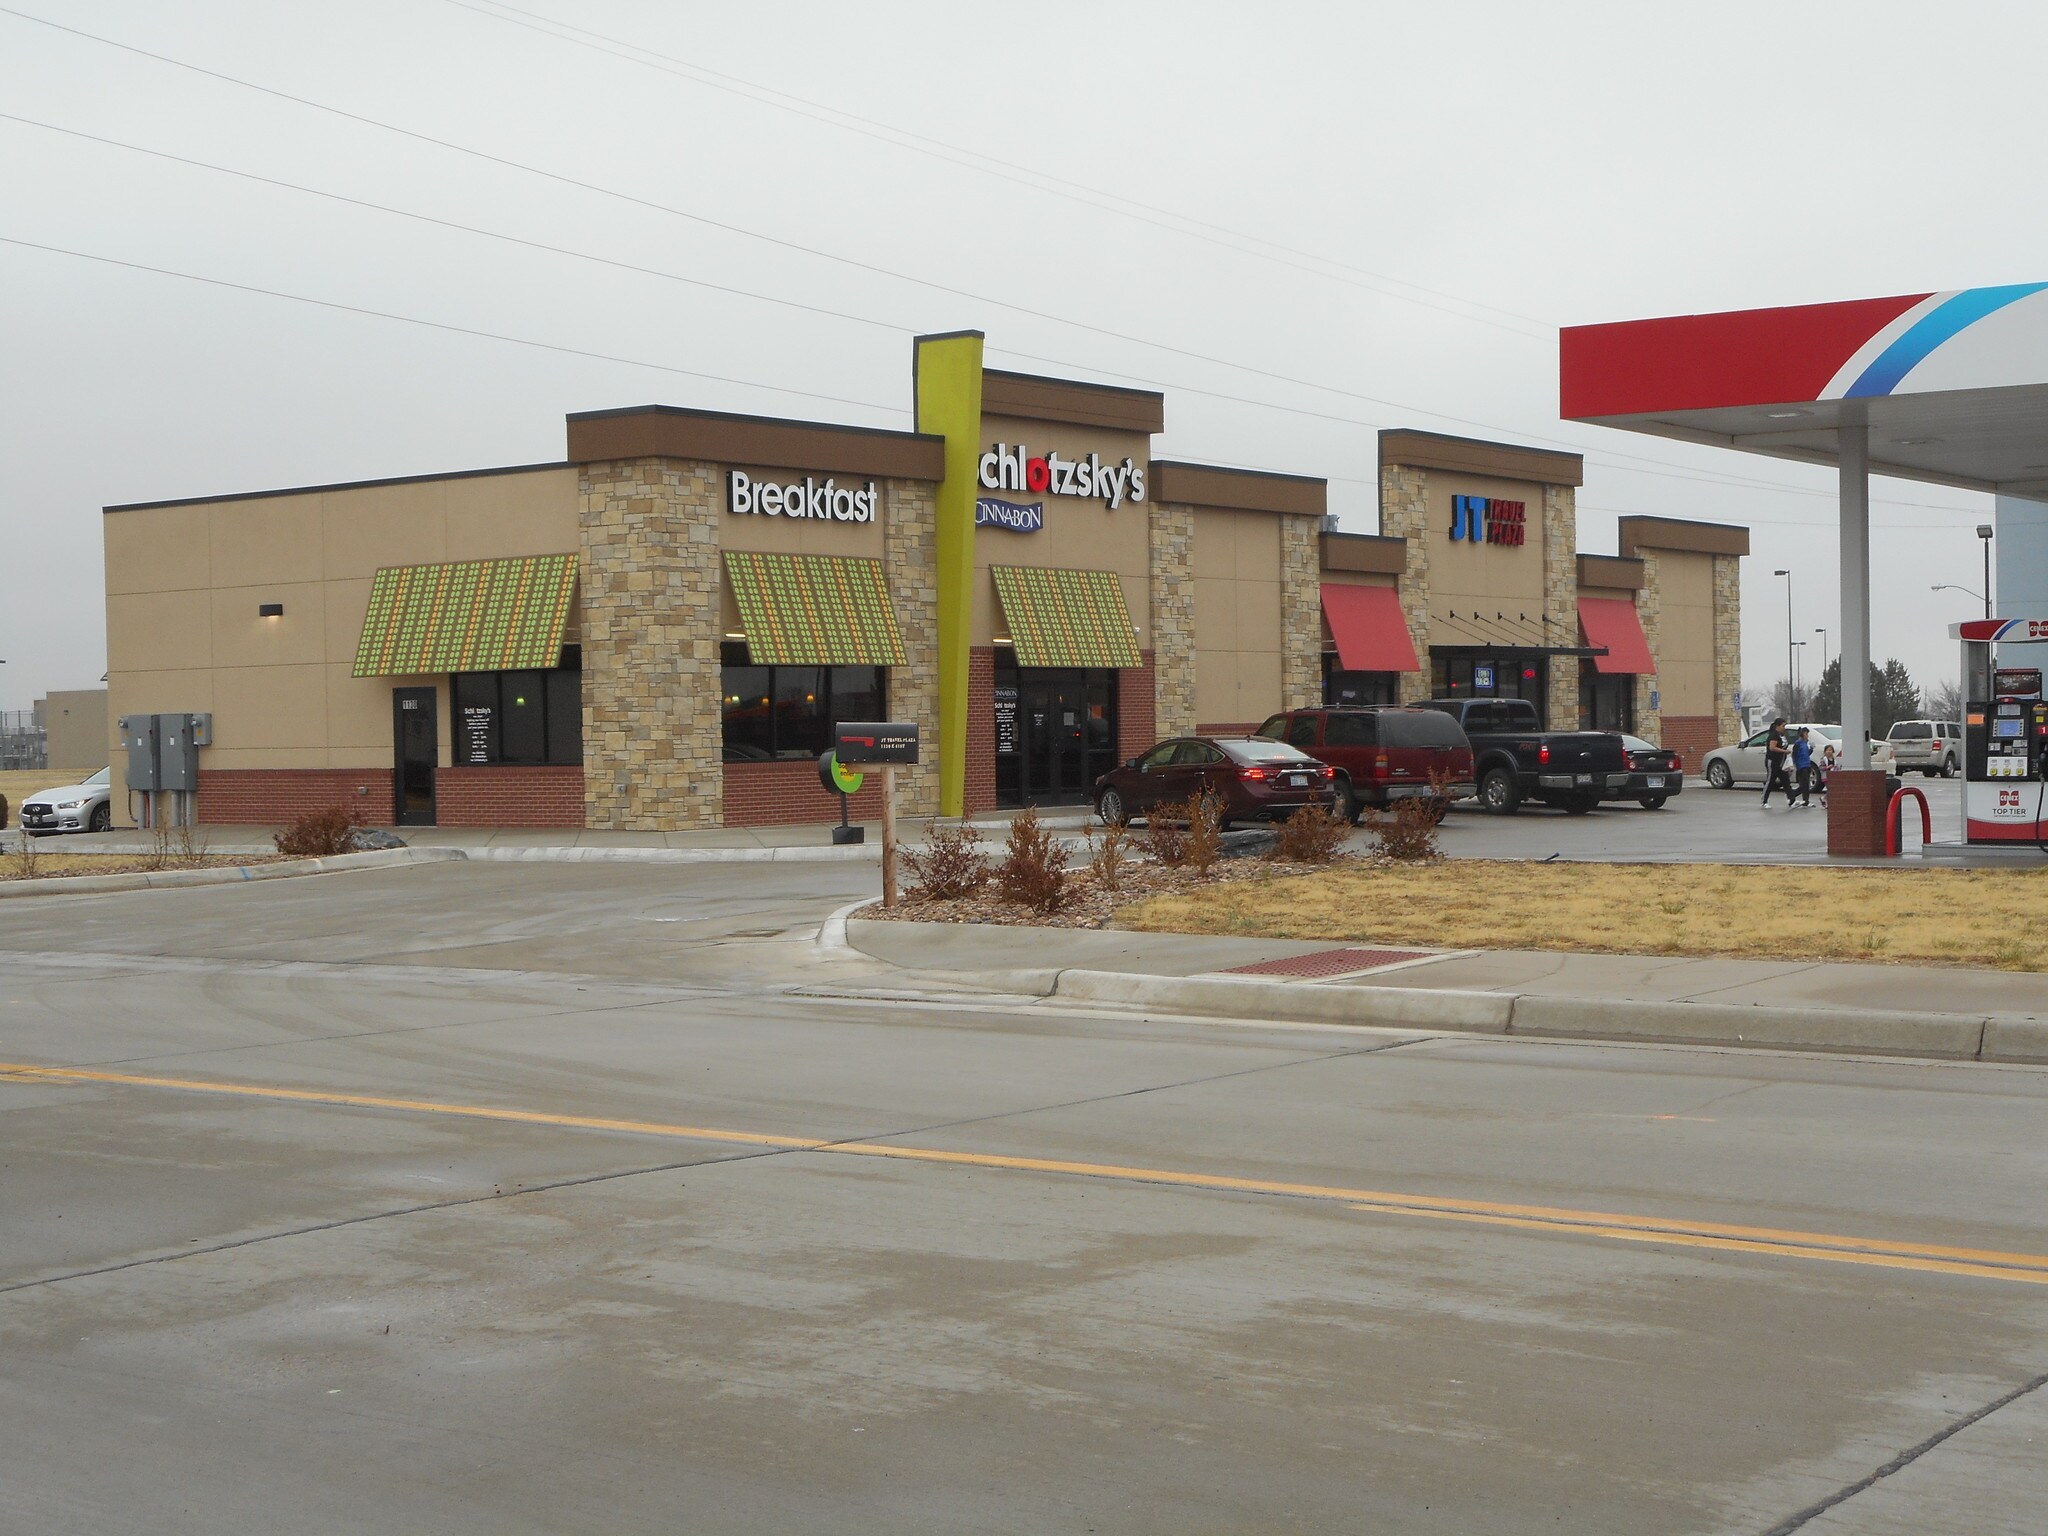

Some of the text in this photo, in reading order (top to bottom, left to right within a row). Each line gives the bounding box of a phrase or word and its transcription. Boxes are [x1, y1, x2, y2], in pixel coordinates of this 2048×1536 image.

[977, 443, 1146, 509] chlotzsky's
[727, 470, 878, 522] Breakfast
[1487, 498, 1526, 522] TRAVEL
[1449, 495, 1486, 542] JT
[1488, 522, 1525, 546] PLAZA
[2041, 726, 2047, 734] 1
